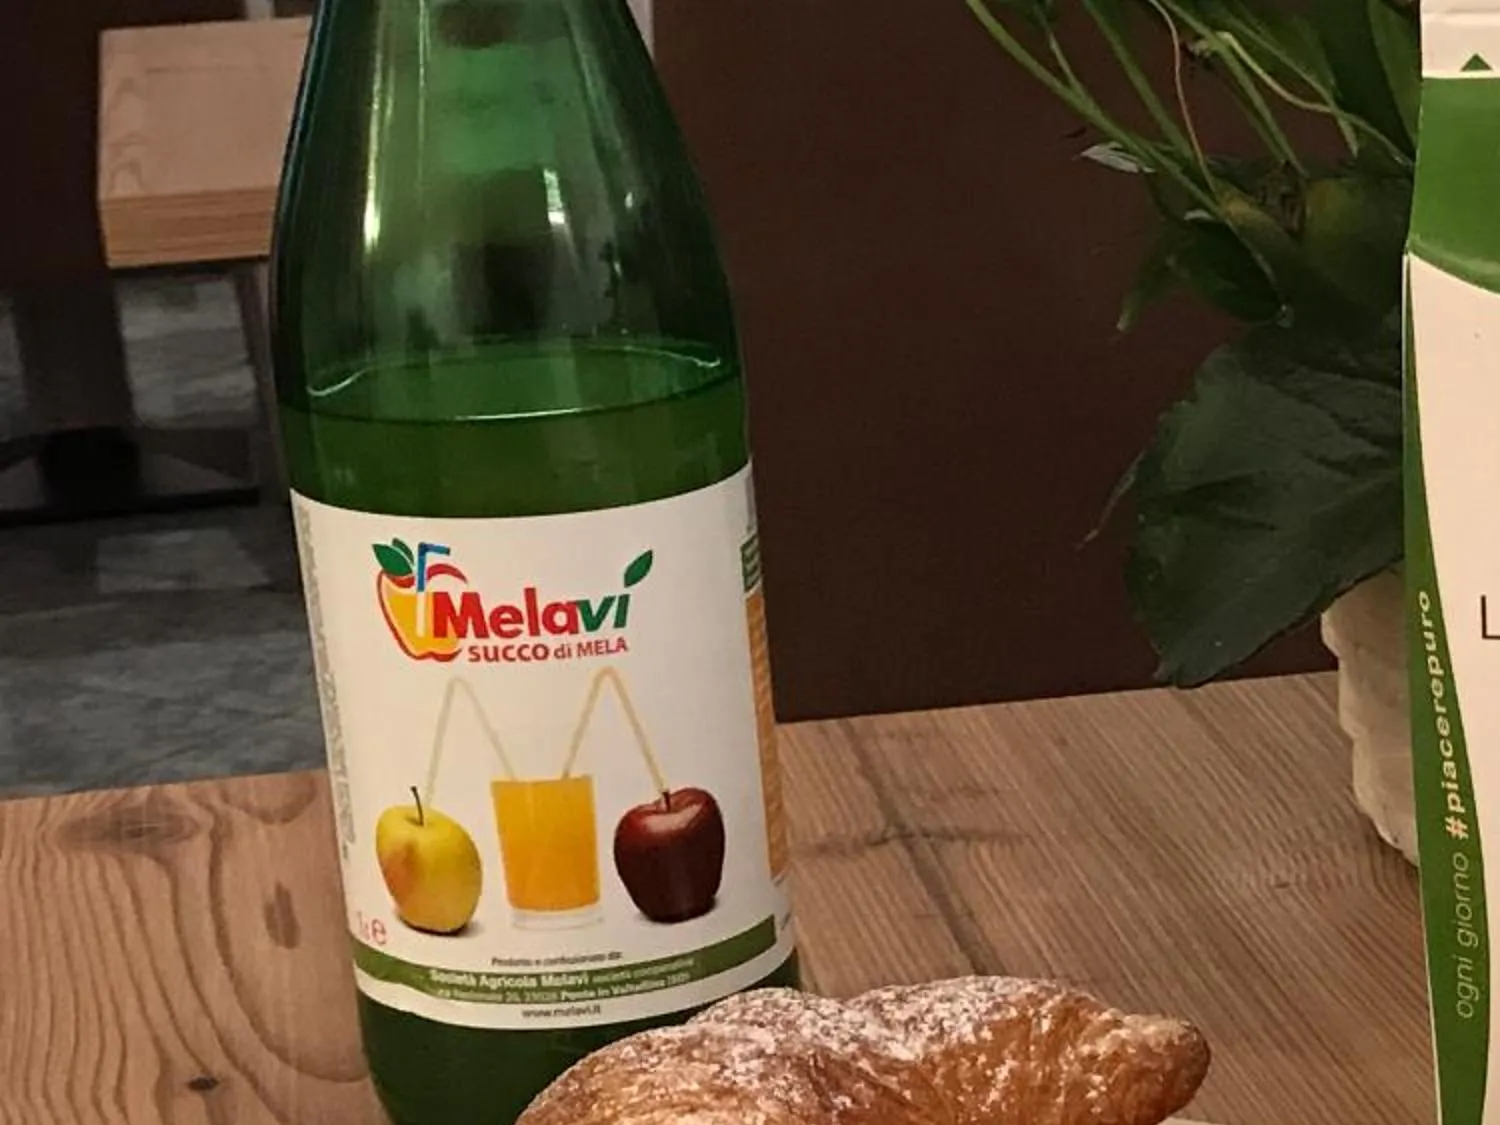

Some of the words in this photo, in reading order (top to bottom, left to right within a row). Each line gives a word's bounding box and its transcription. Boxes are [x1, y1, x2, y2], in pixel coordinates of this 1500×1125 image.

[468, 642, 549, 663] SUCCO
[554, 641, 573, 660] di
[576, 637, 629, 658] MELA
[1419, 590, 1470, 839] #piacerepuro
[1452, 851, 1479, 948] giorno
[479, 974, 538, 990] Agricola
[1455, 957, 1479, 1020] ogni
